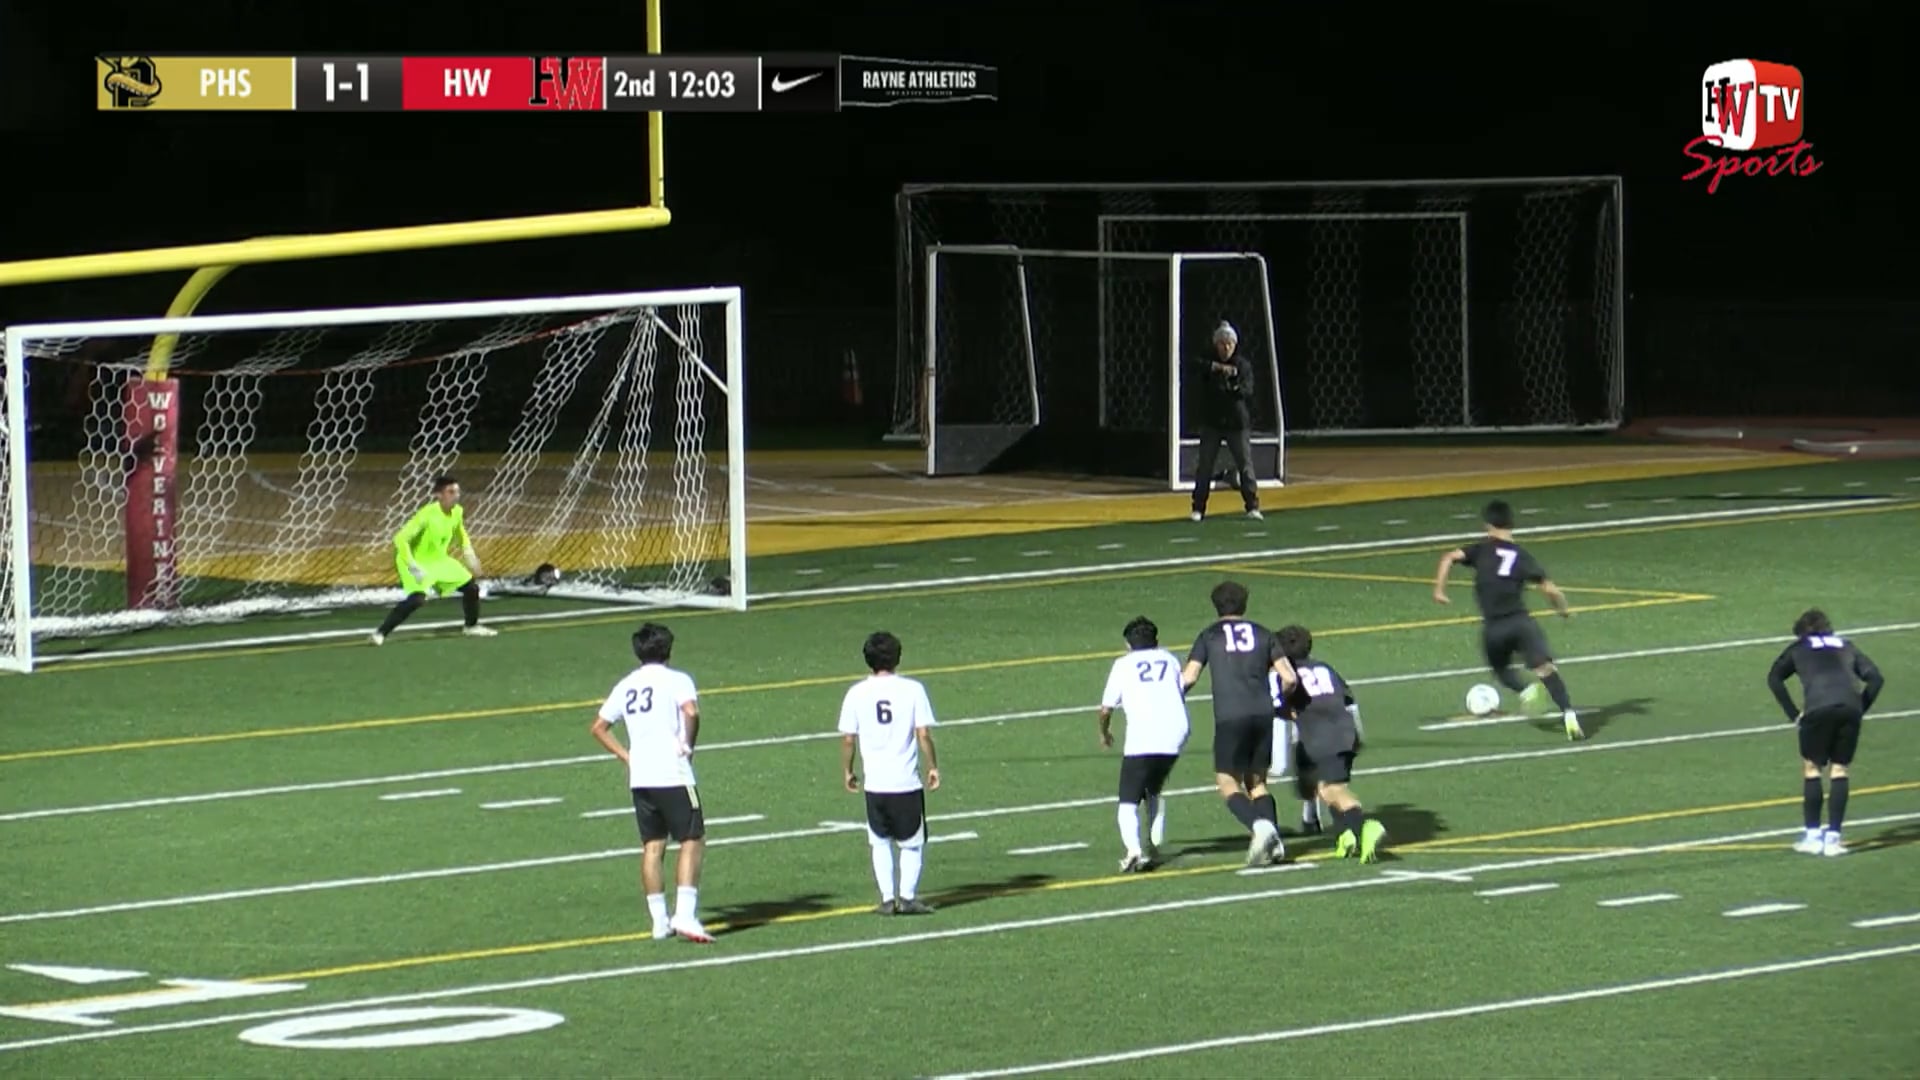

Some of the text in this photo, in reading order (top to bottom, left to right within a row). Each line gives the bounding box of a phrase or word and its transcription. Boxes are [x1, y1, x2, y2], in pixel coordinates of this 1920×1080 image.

[1495, 547, 1518, 576] 7
[1222, 622, 1255, 652] 13
[1136, 660, 1168, 682] 27
[626, 686, 653, 714] 23
[876, 699, 893, 725] 6
